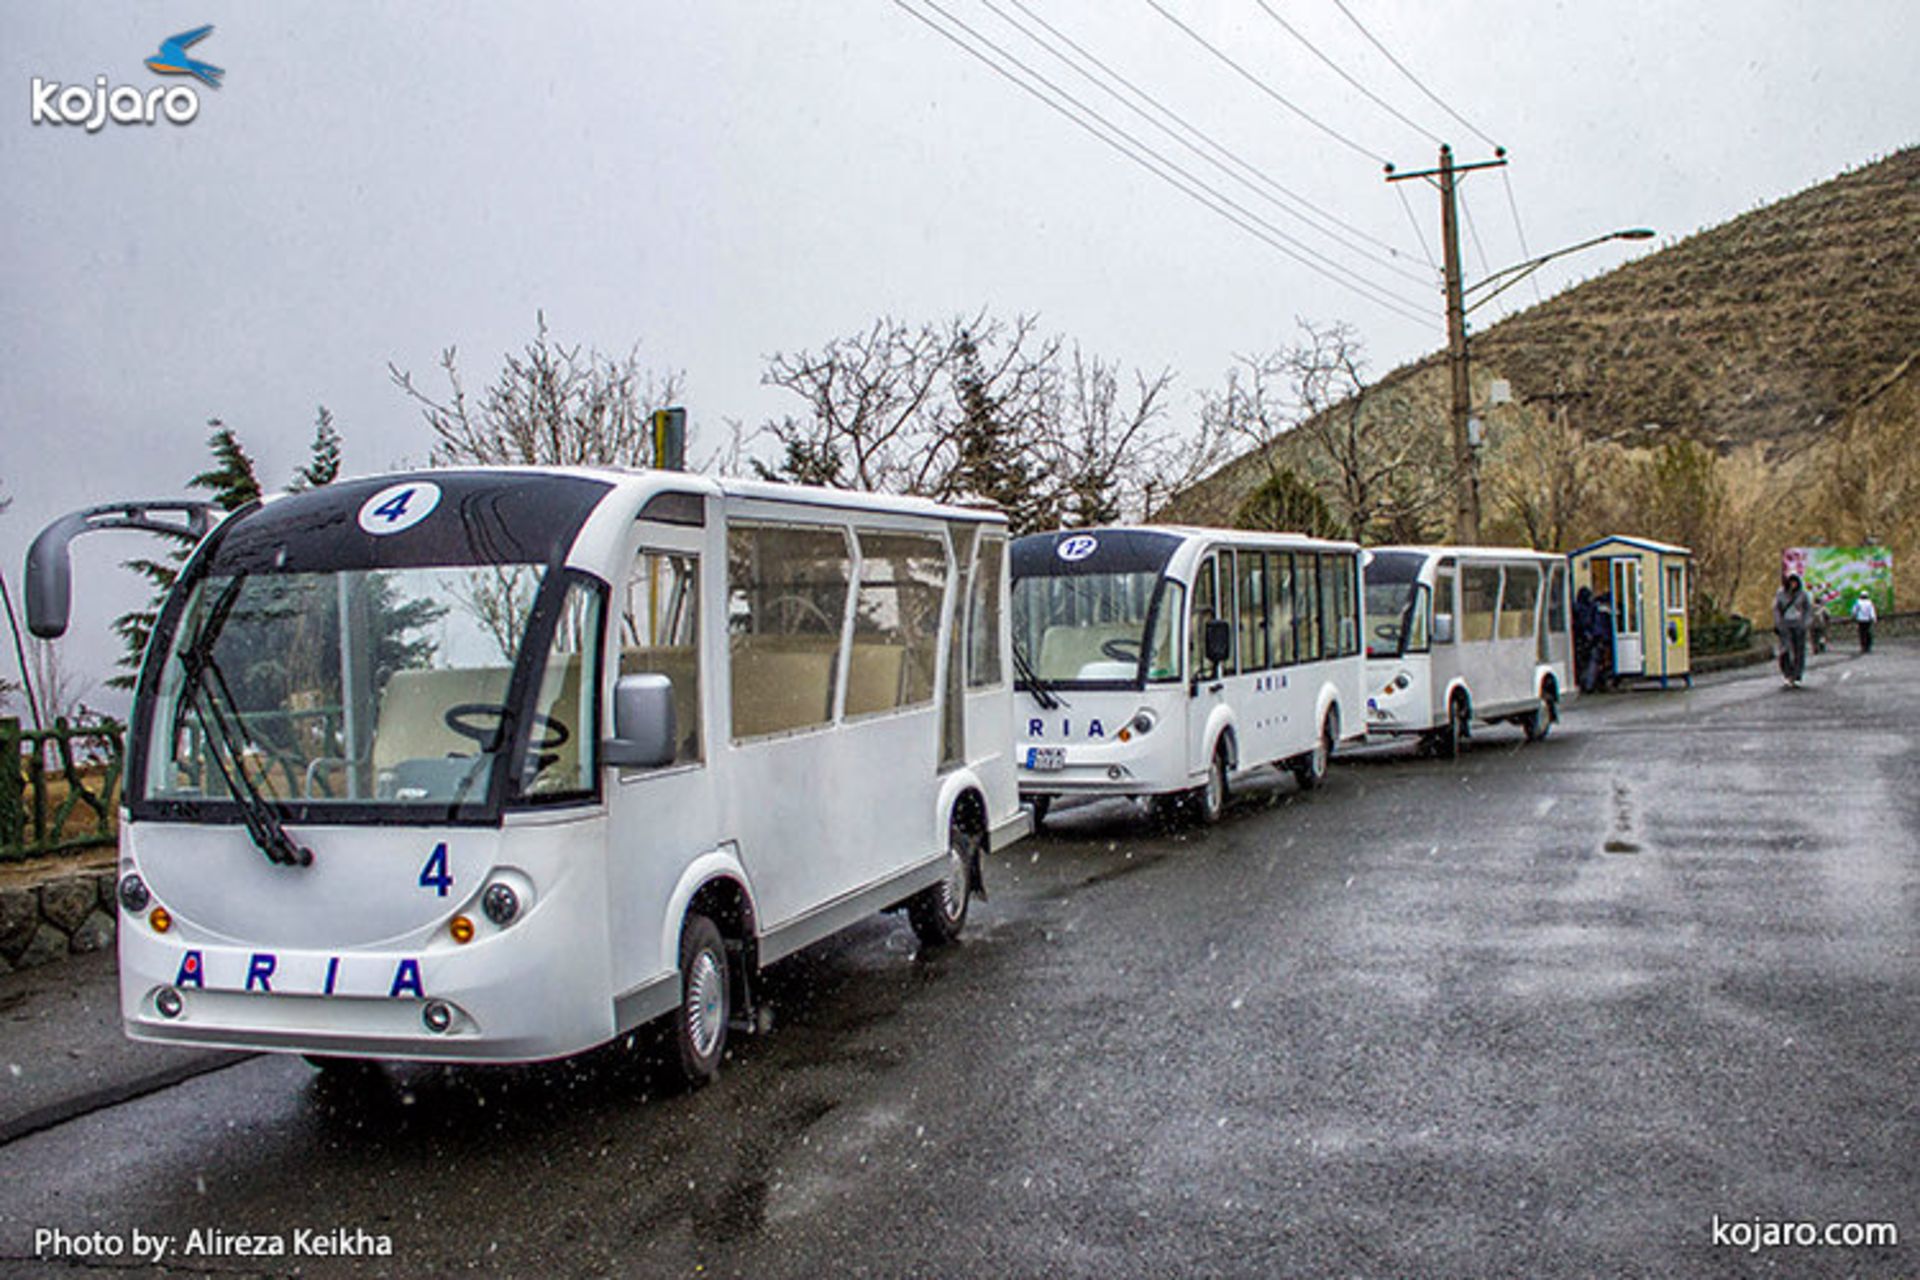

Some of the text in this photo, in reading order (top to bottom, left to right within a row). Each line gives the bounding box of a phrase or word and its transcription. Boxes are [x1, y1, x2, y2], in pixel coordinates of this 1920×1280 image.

[373, 488, 417, 522] 4
[1066, 540, 1093, 556] 12
[419, 842, 453, 897] 4
[175, 950, 424, 997] ARIA
